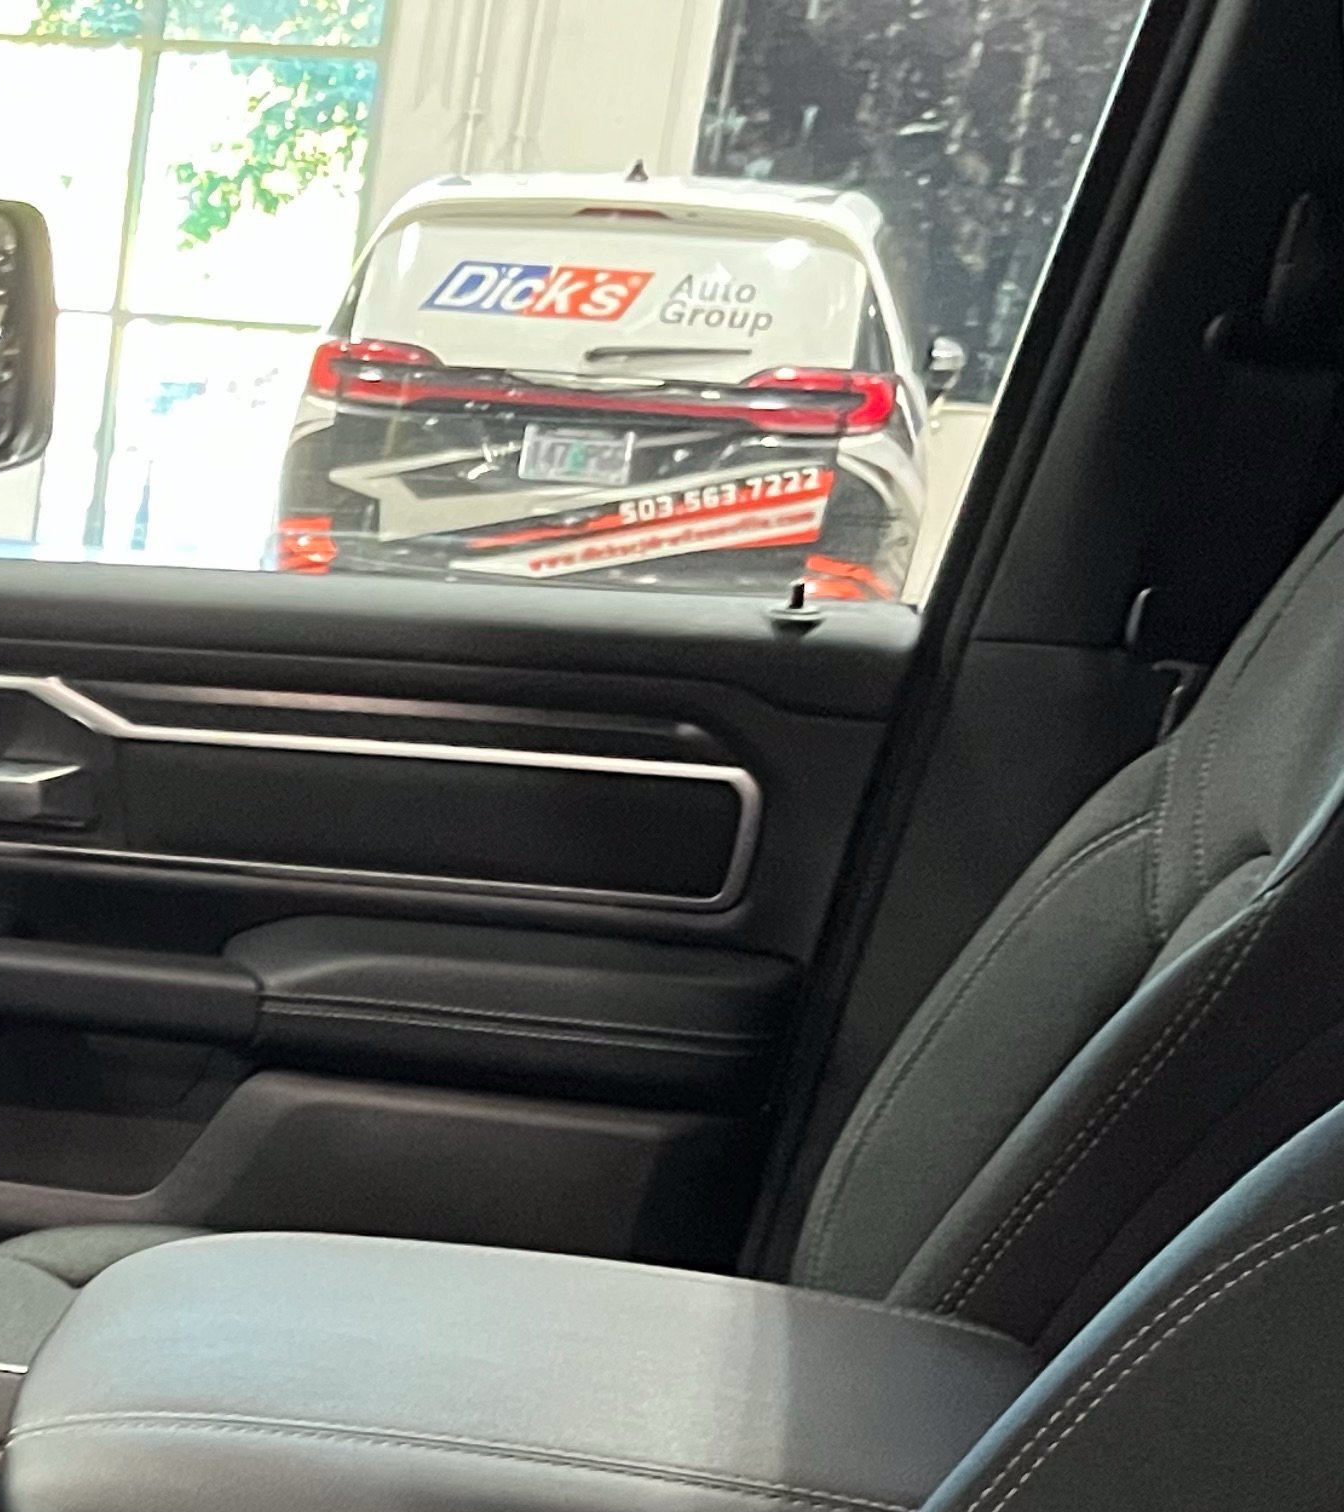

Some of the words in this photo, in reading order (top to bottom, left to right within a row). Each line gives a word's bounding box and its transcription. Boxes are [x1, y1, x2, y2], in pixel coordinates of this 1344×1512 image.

[668, 274, 758, 303] Auto
[658, 299, 774, 338] Group
[618, 468, 822, 526] 503.563.7222
